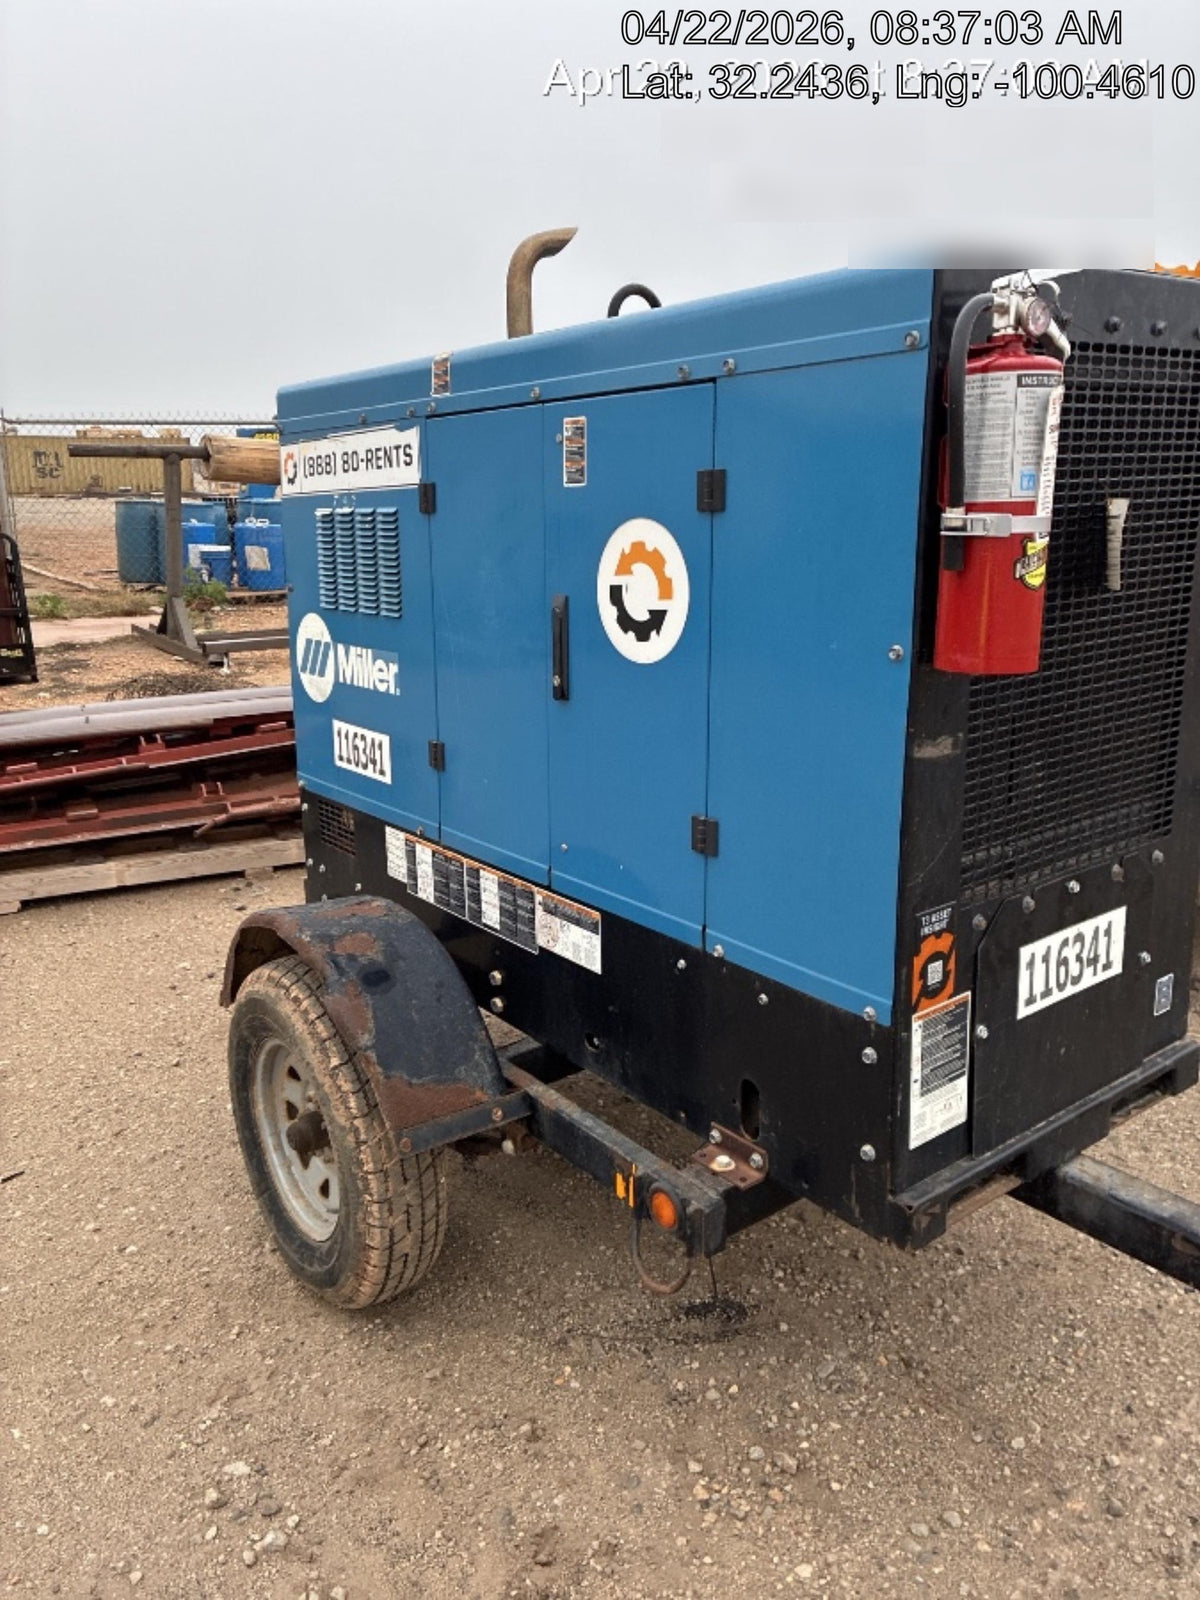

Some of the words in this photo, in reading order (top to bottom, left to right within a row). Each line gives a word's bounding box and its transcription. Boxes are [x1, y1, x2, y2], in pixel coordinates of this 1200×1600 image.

[303, 452, 337, 479] (888)
[341, 443, 413, 474] 80-RENTS
[337, 643, 399, 696] Miller
[337, 726, 386, 777] 116341
[1024, 920, 1114, 1008] 116341
